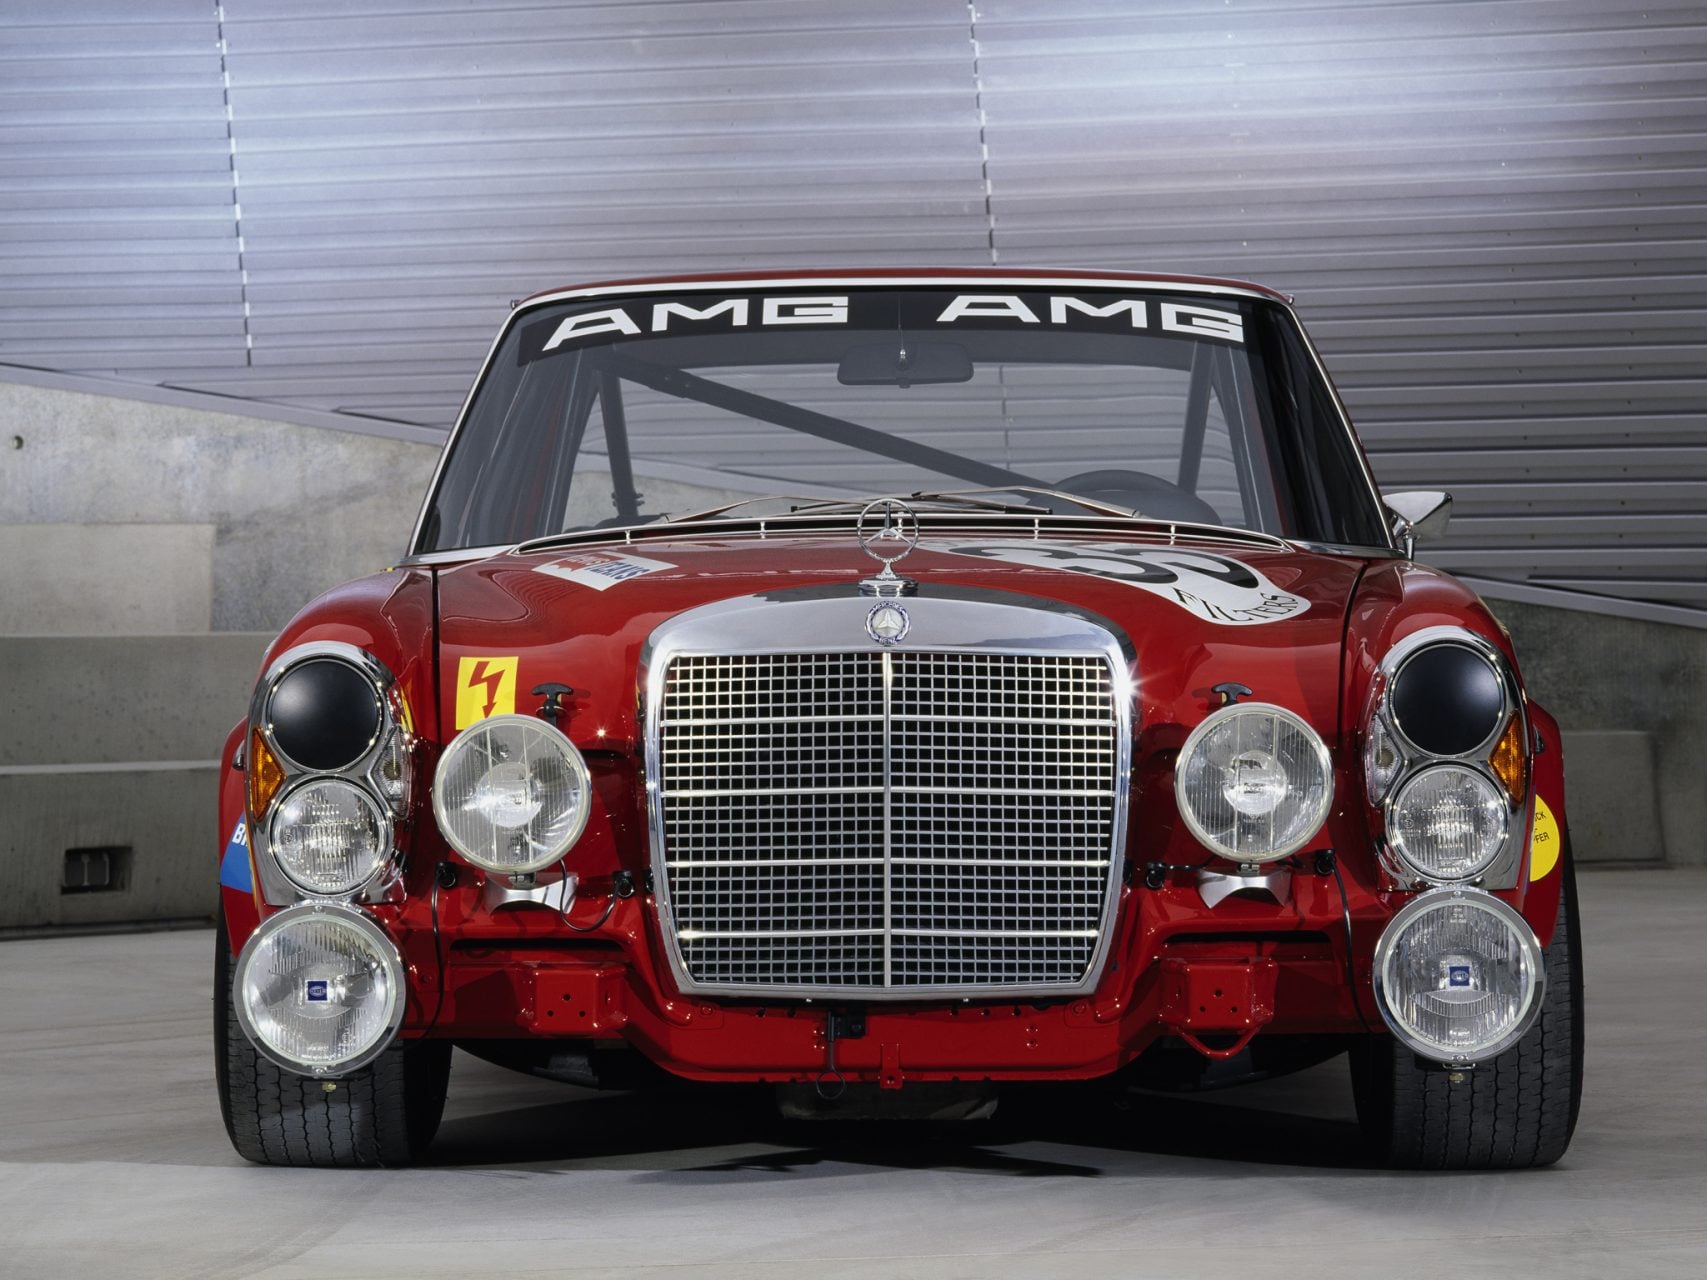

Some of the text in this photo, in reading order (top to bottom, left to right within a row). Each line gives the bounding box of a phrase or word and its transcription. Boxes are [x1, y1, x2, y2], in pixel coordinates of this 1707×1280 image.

[542, 295, 1244, 351] AMG AMG
[1172, 586, 1299, 621] FILTERS
[1534, 831, 1550, 844] FER
